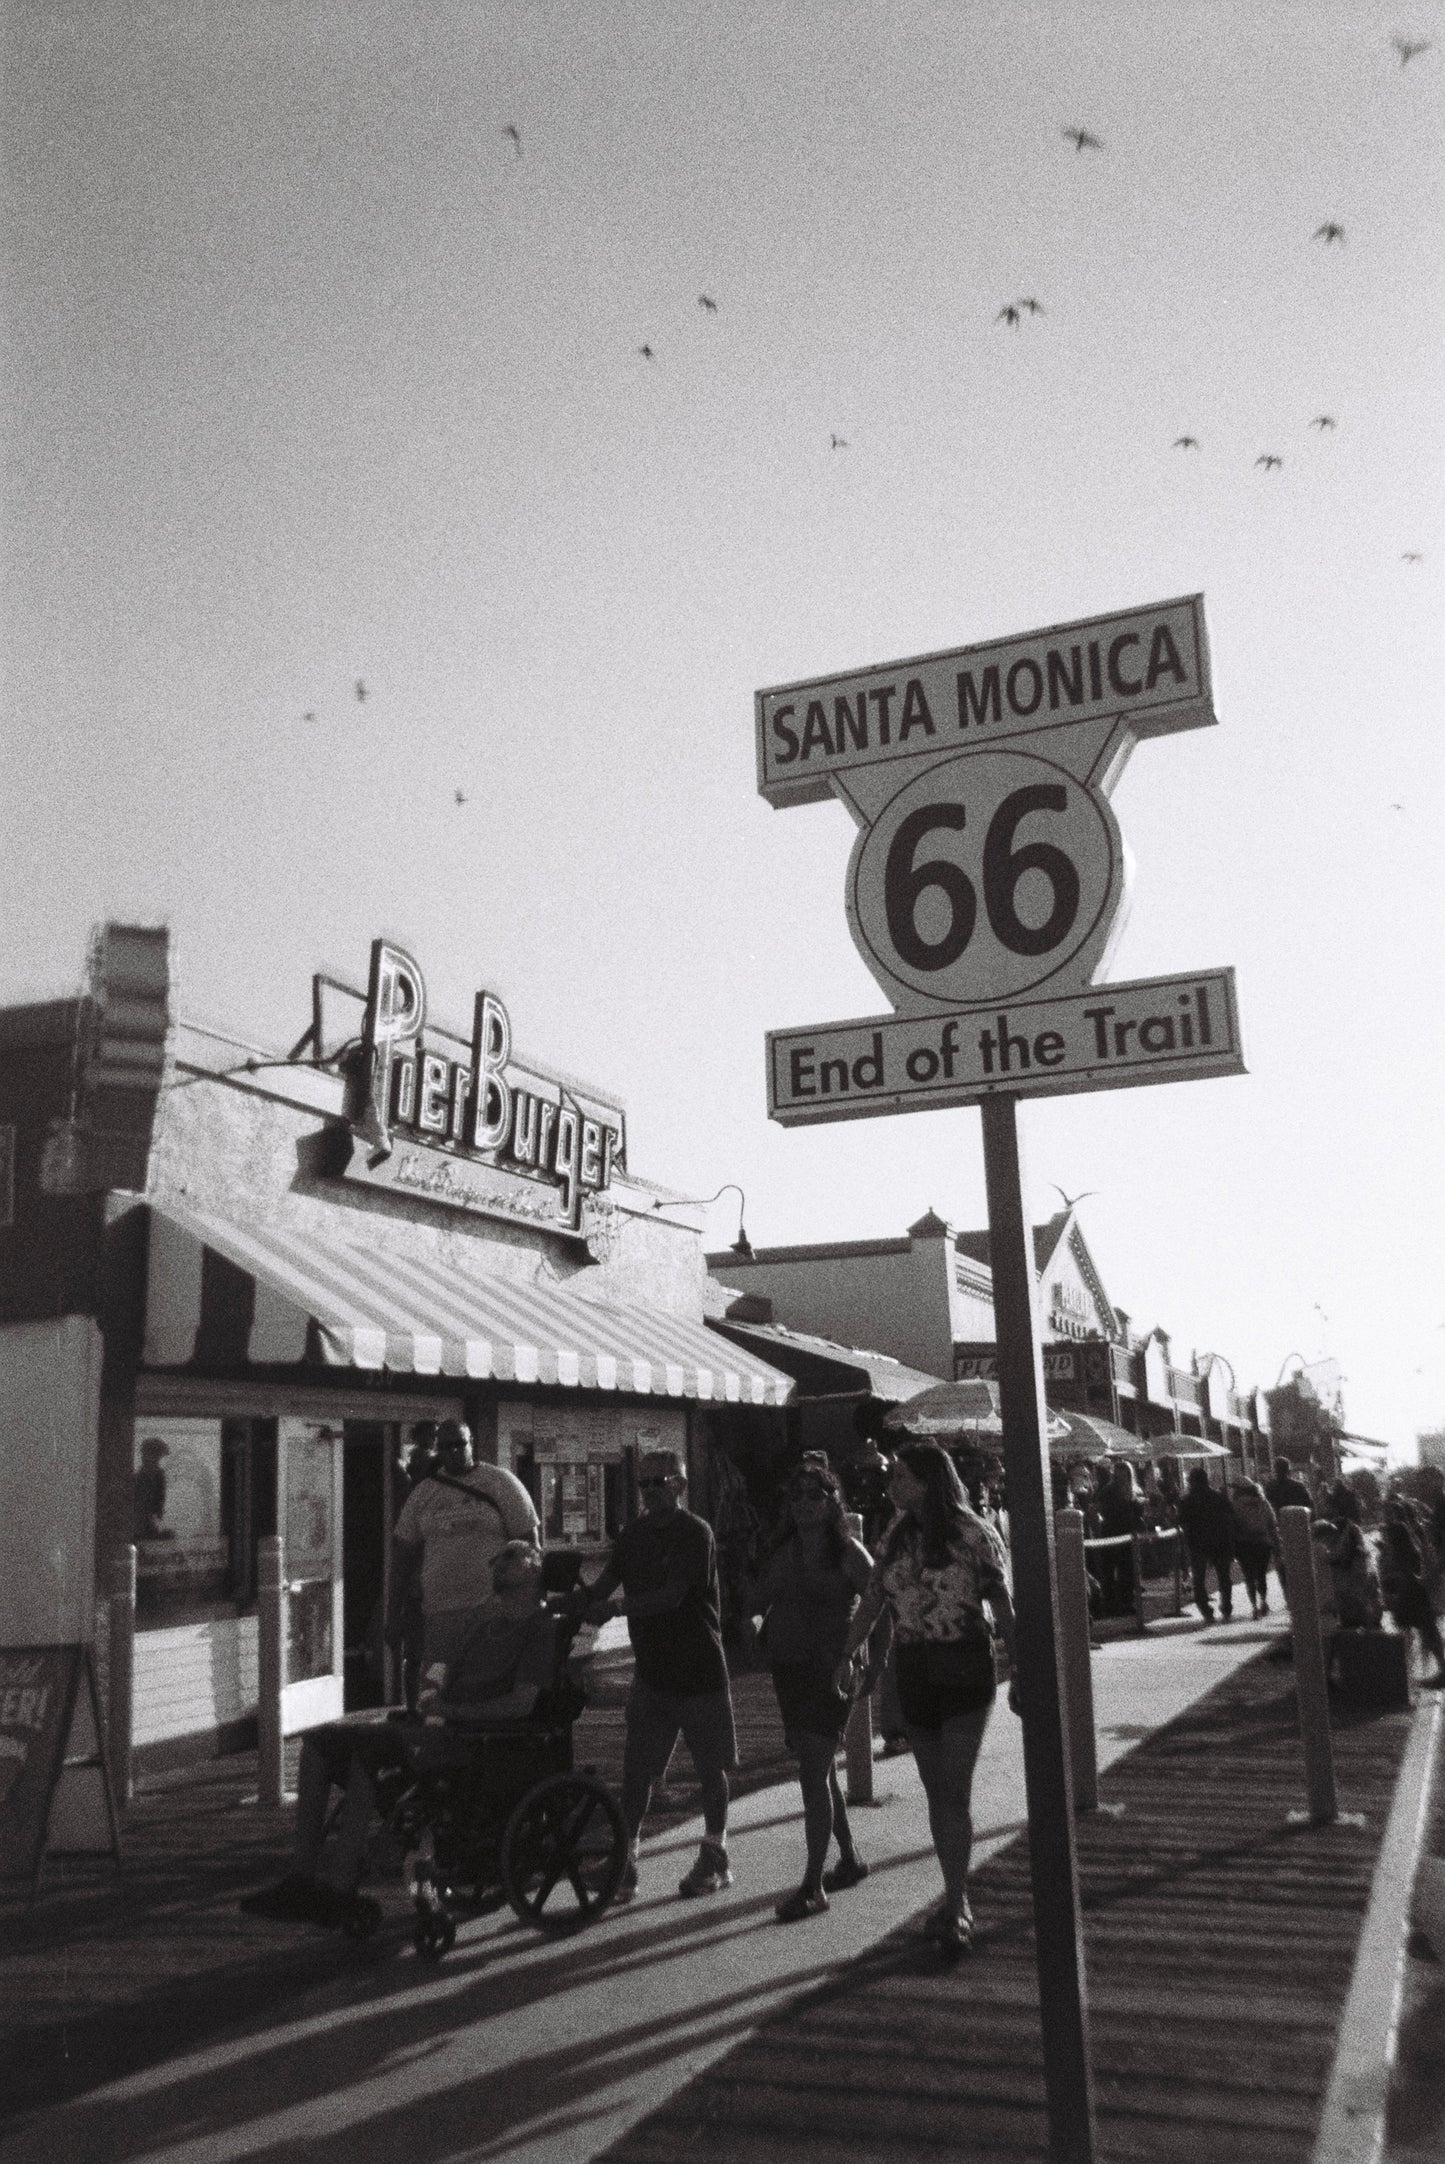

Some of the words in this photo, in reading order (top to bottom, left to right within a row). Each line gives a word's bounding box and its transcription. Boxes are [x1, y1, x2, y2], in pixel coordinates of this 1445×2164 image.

[772, 677, 937, 765] SANTA
[955, 624, 1187, 729] MONICA
[884, 784, 1080, 972] 66
[472, 990, 621, 1231] Burger
[788, 1033, 884, 1098] End
[905, 1022, 959, 1084] of
[979, 1015, 1066, 1073] the
[1084, 987, 1213, 1060] Trail
